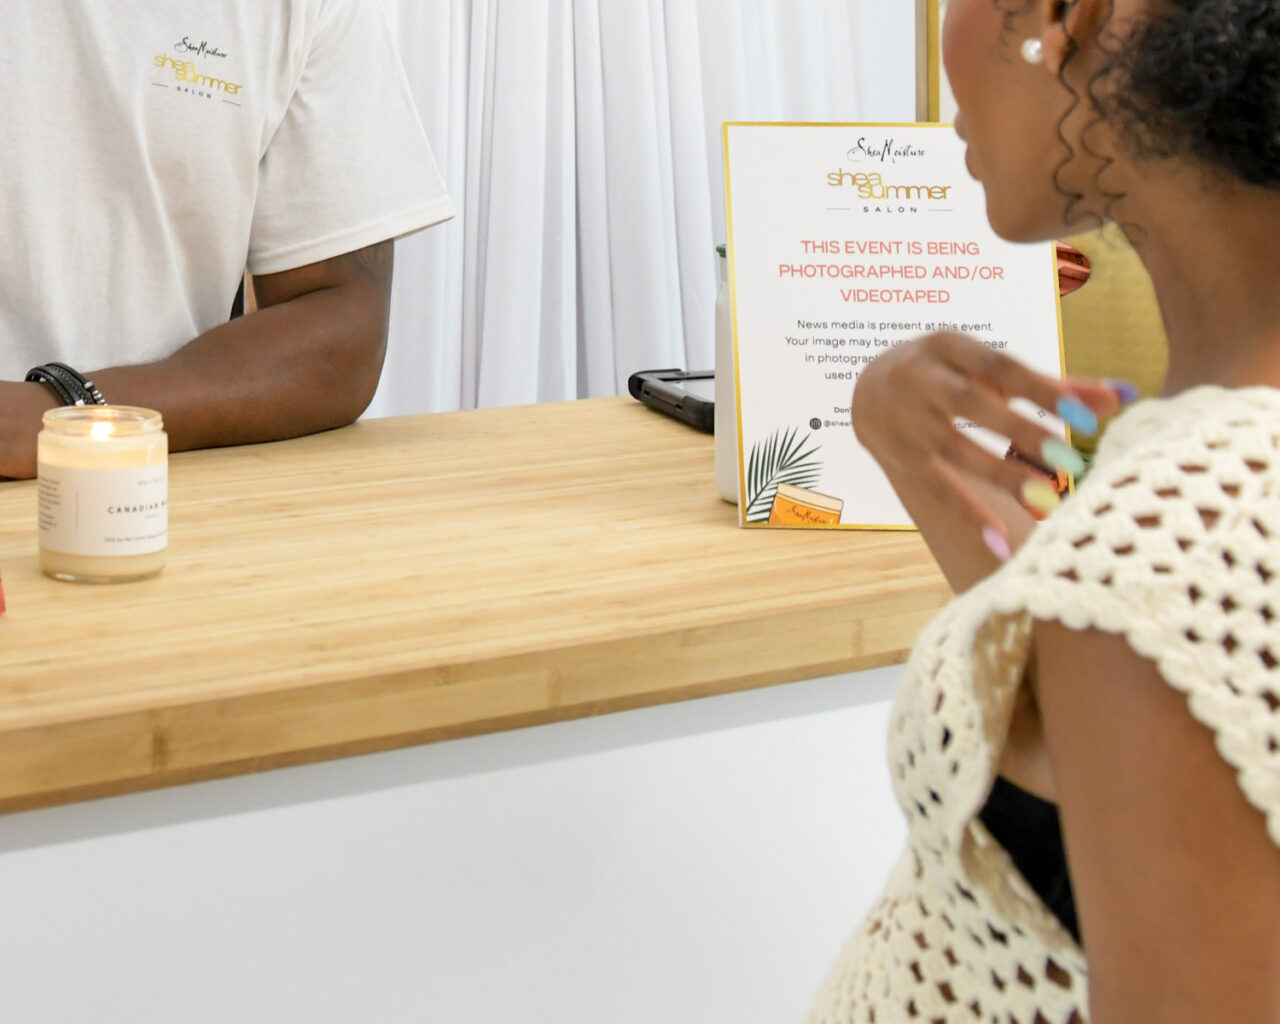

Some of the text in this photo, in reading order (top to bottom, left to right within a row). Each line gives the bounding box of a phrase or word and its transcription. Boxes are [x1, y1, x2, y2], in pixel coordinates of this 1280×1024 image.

[153, 53, 196, 72] shea
[175, 69, 242, 95] summer
[176, 86, 212, 99] SALON
[846, 137, 927, 164] SheaMoisture
[827, 168, 882, 188] shea
[857, 182, 952, 200] summer
[800, 240, 980, 256] THIS EVENT IS BEING
[779, 264, 1005, 281] PHOTOGRAPHED AND/OR
[840, 289, 951, 304] VIDEOTAPED
[797, 319, 994, 333] News media is present at this event.
[785, 336, 809, 346] Your
[812, 336, 846, 349] image
[849, 338, 871, 349] may
[874, 336, 889, 347] be
[805, 353, 815, 363] in
[824, 370, 853, 380] used
